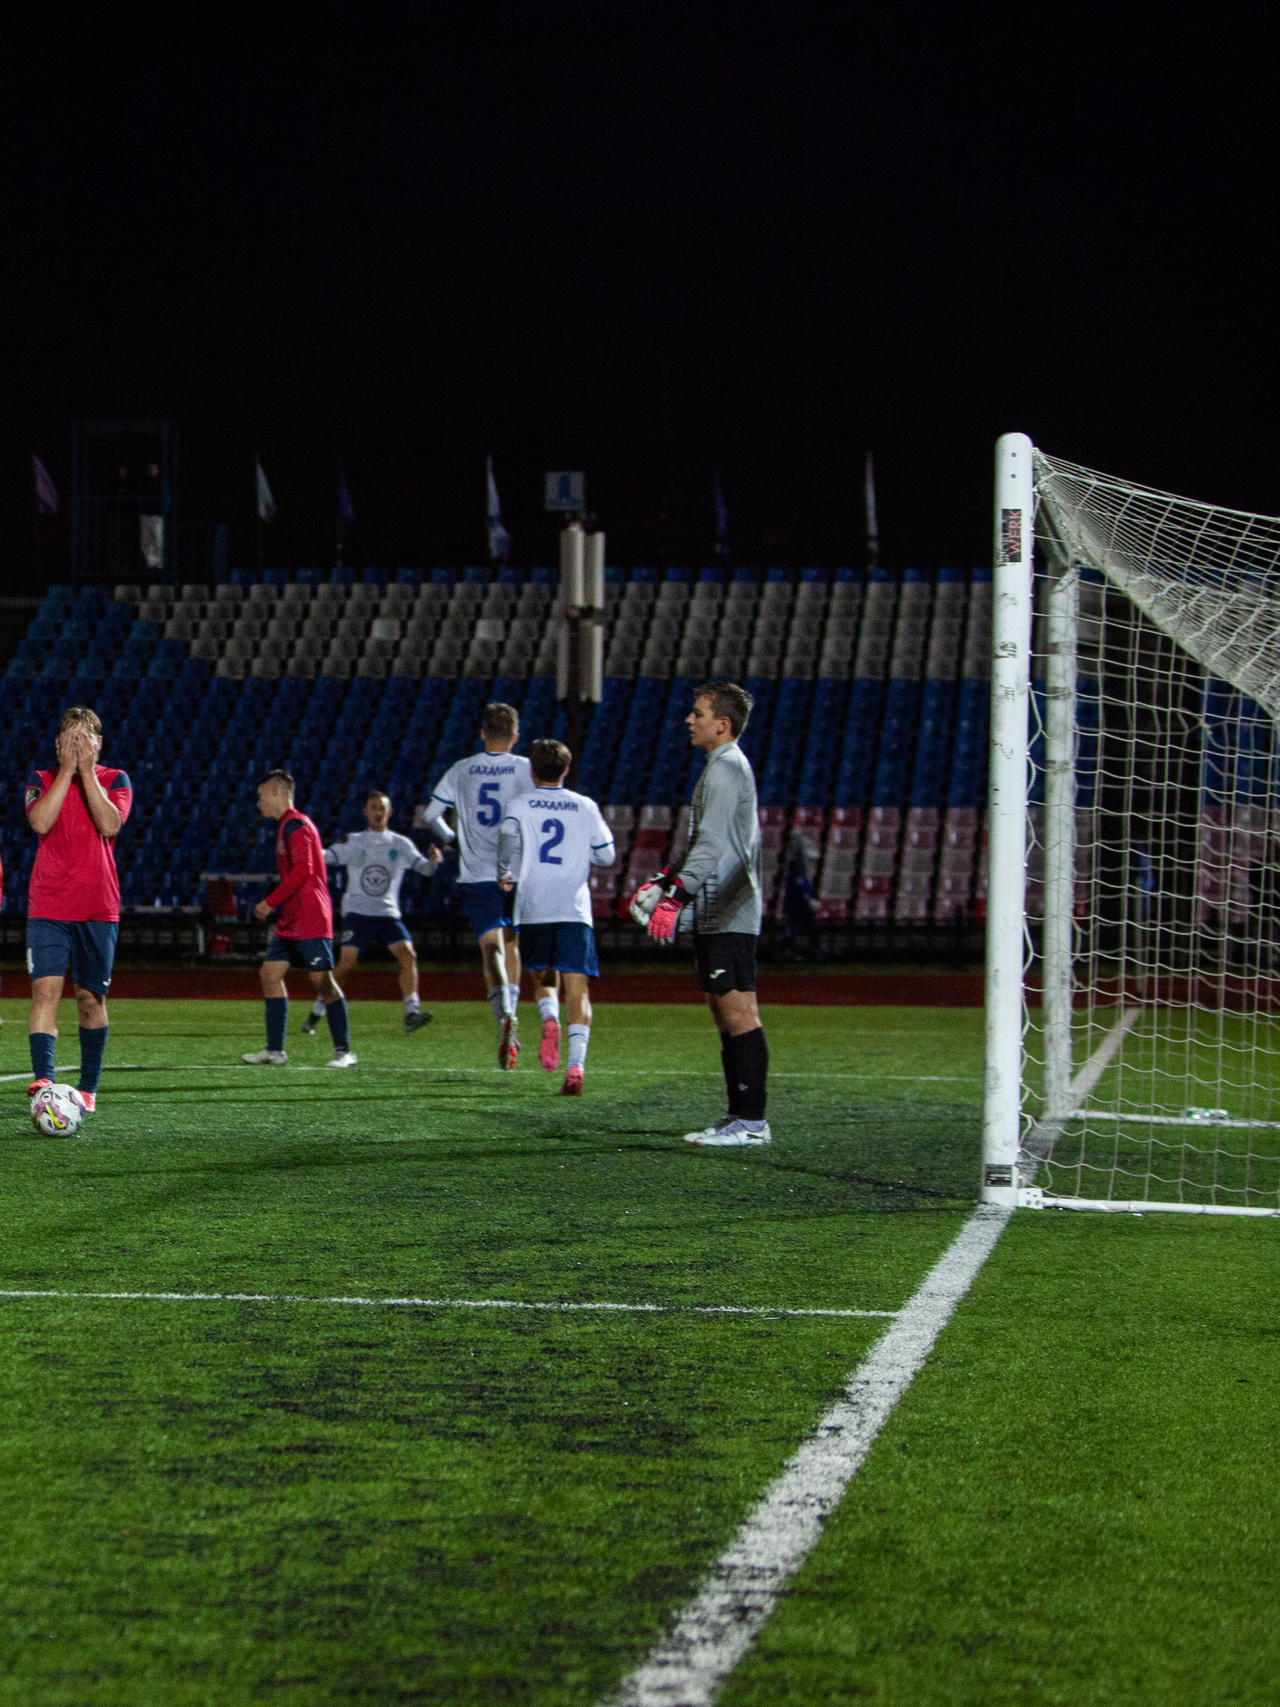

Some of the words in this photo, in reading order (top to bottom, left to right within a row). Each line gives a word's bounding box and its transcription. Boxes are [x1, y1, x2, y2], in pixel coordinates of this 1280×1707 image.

[1009, 510, 1022, 555] WERK
[469, 764, 516, 776] САХАЛИН
[477, 782, 502, 827] 5
[528, 799, 580, 813] САХАЛИН
[539, 818, 564, 865] 2
